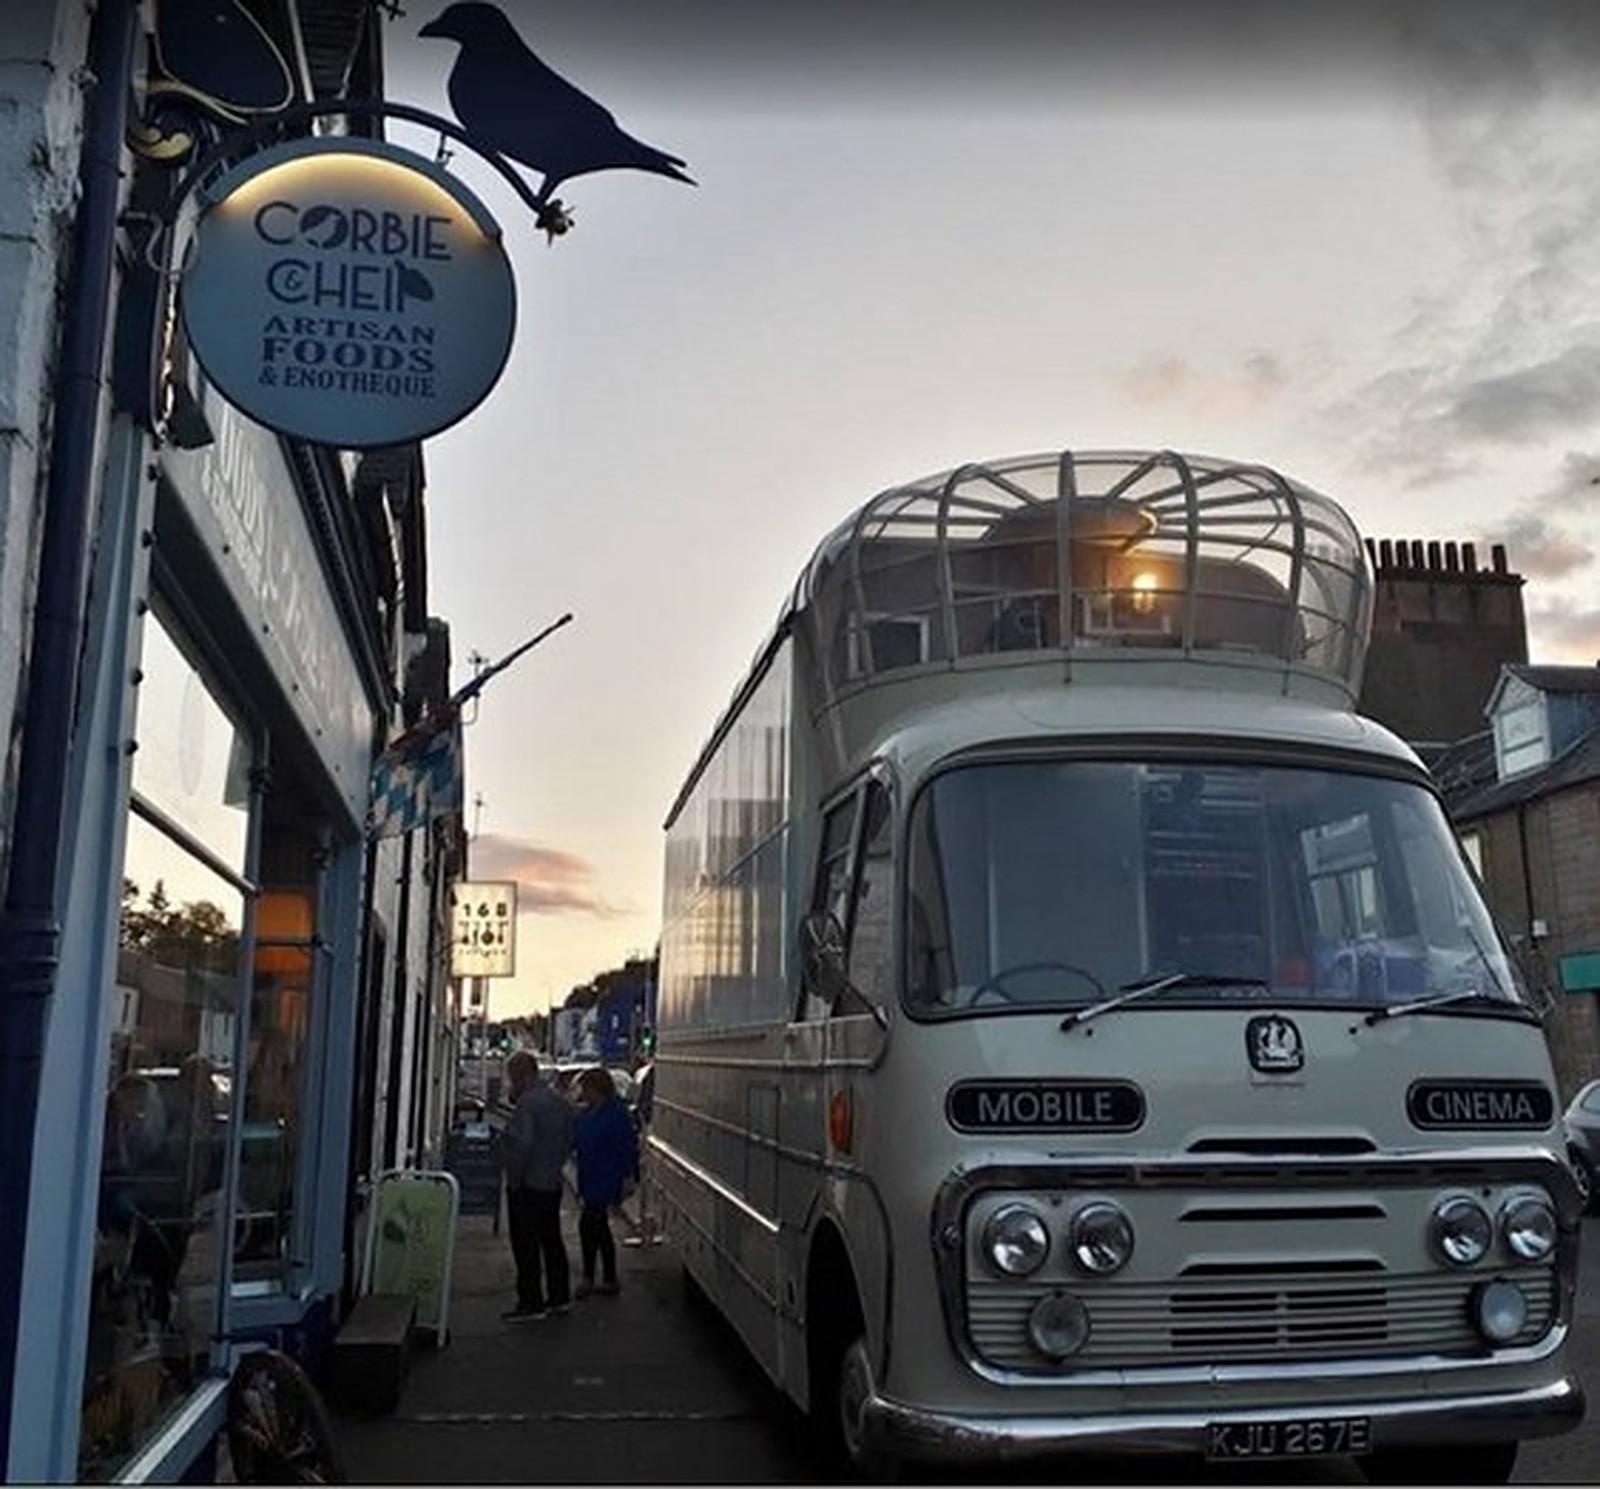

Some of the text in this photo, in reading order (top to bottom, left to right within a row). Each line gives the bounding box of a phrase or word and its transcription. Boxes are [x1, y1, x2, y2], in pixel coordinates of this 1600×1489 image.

[255, 201, 453, 261] CORBIE
[263, 316, 435, 345] ARTISAN
[263, 338, 434, 373] FOODS
[258, 366, 436, 397] & ENOTHEQUE
[977, 1091, 1114, 1122] MOBILE
[1426, 1091, 1535, 1119] CINEMA
[1212, 1418, 1367, 1455] KJU 267E
